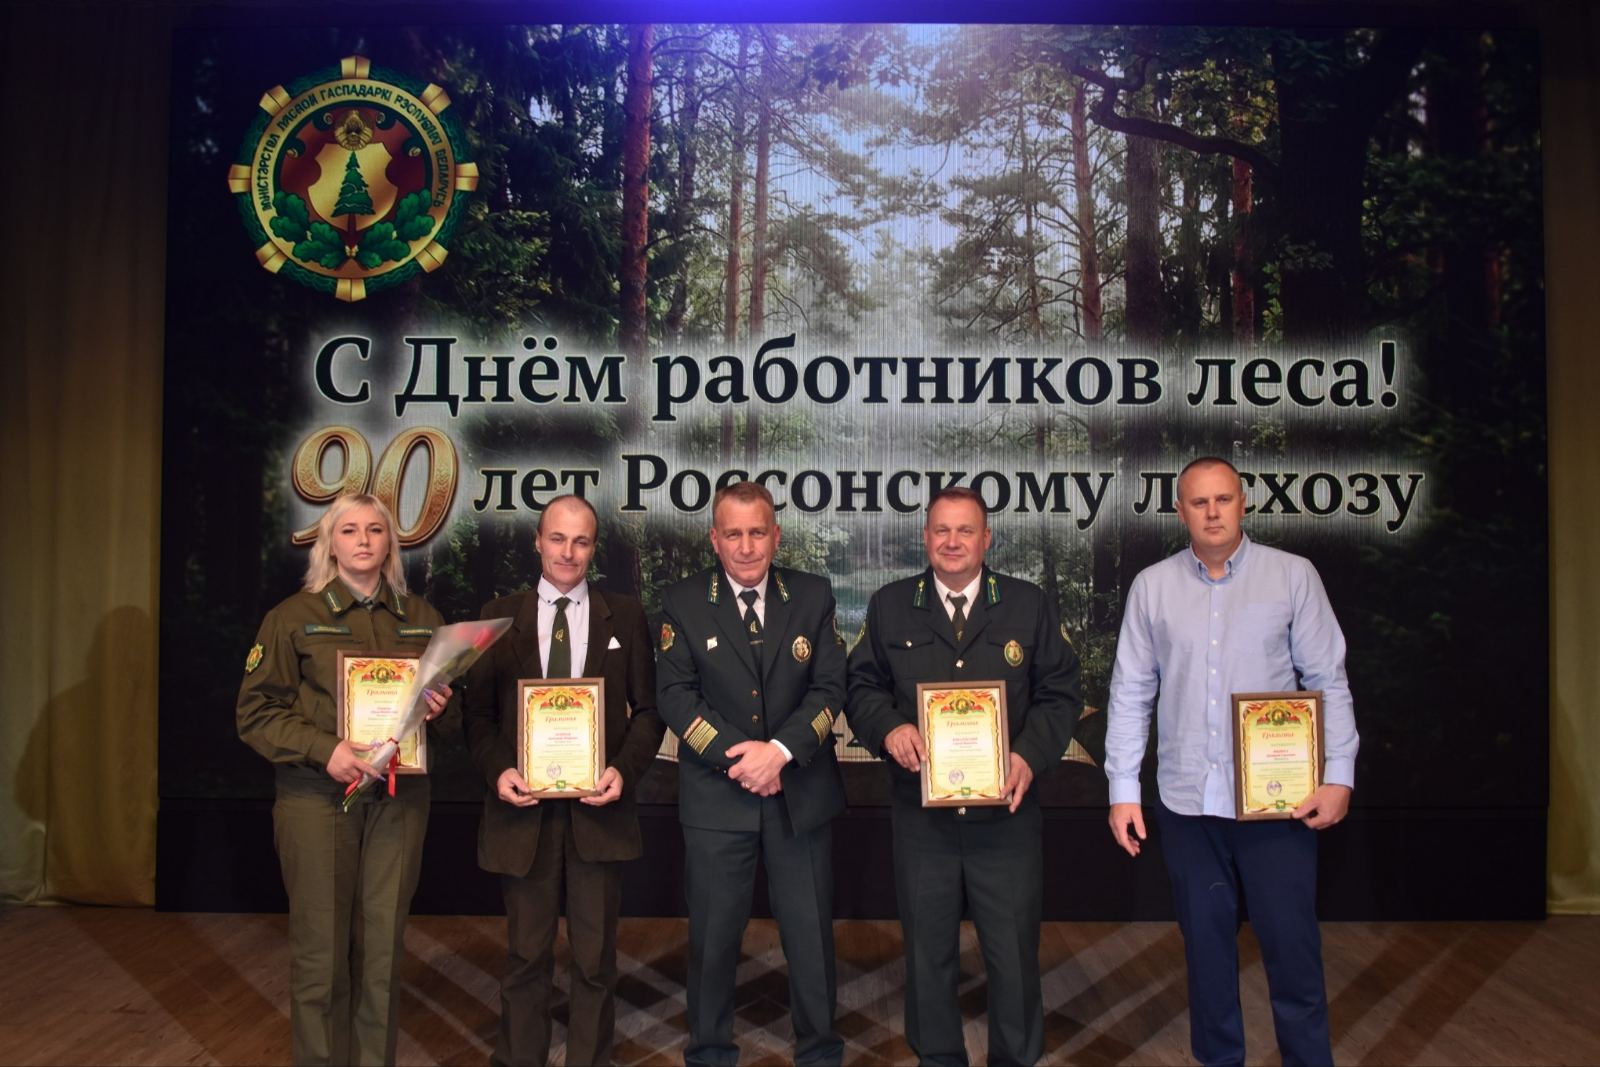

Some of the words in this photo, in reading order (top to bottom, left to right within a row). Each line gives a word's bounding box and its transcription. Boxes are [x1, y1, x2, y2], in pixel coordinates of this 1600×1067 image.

[320, 84, 393, 101] ГАСПАДАРКІ
[314, 336, 371, 403] С
[395, 336, 627, 418] Днём
[652, 332, 1162, 421] работников
[1187, 341, 1399, 407] леса!
[292, 426, 459, 547] 90
[473, 468, 600, 511] лет
[1133, 472, 1425, 533] лхозу
